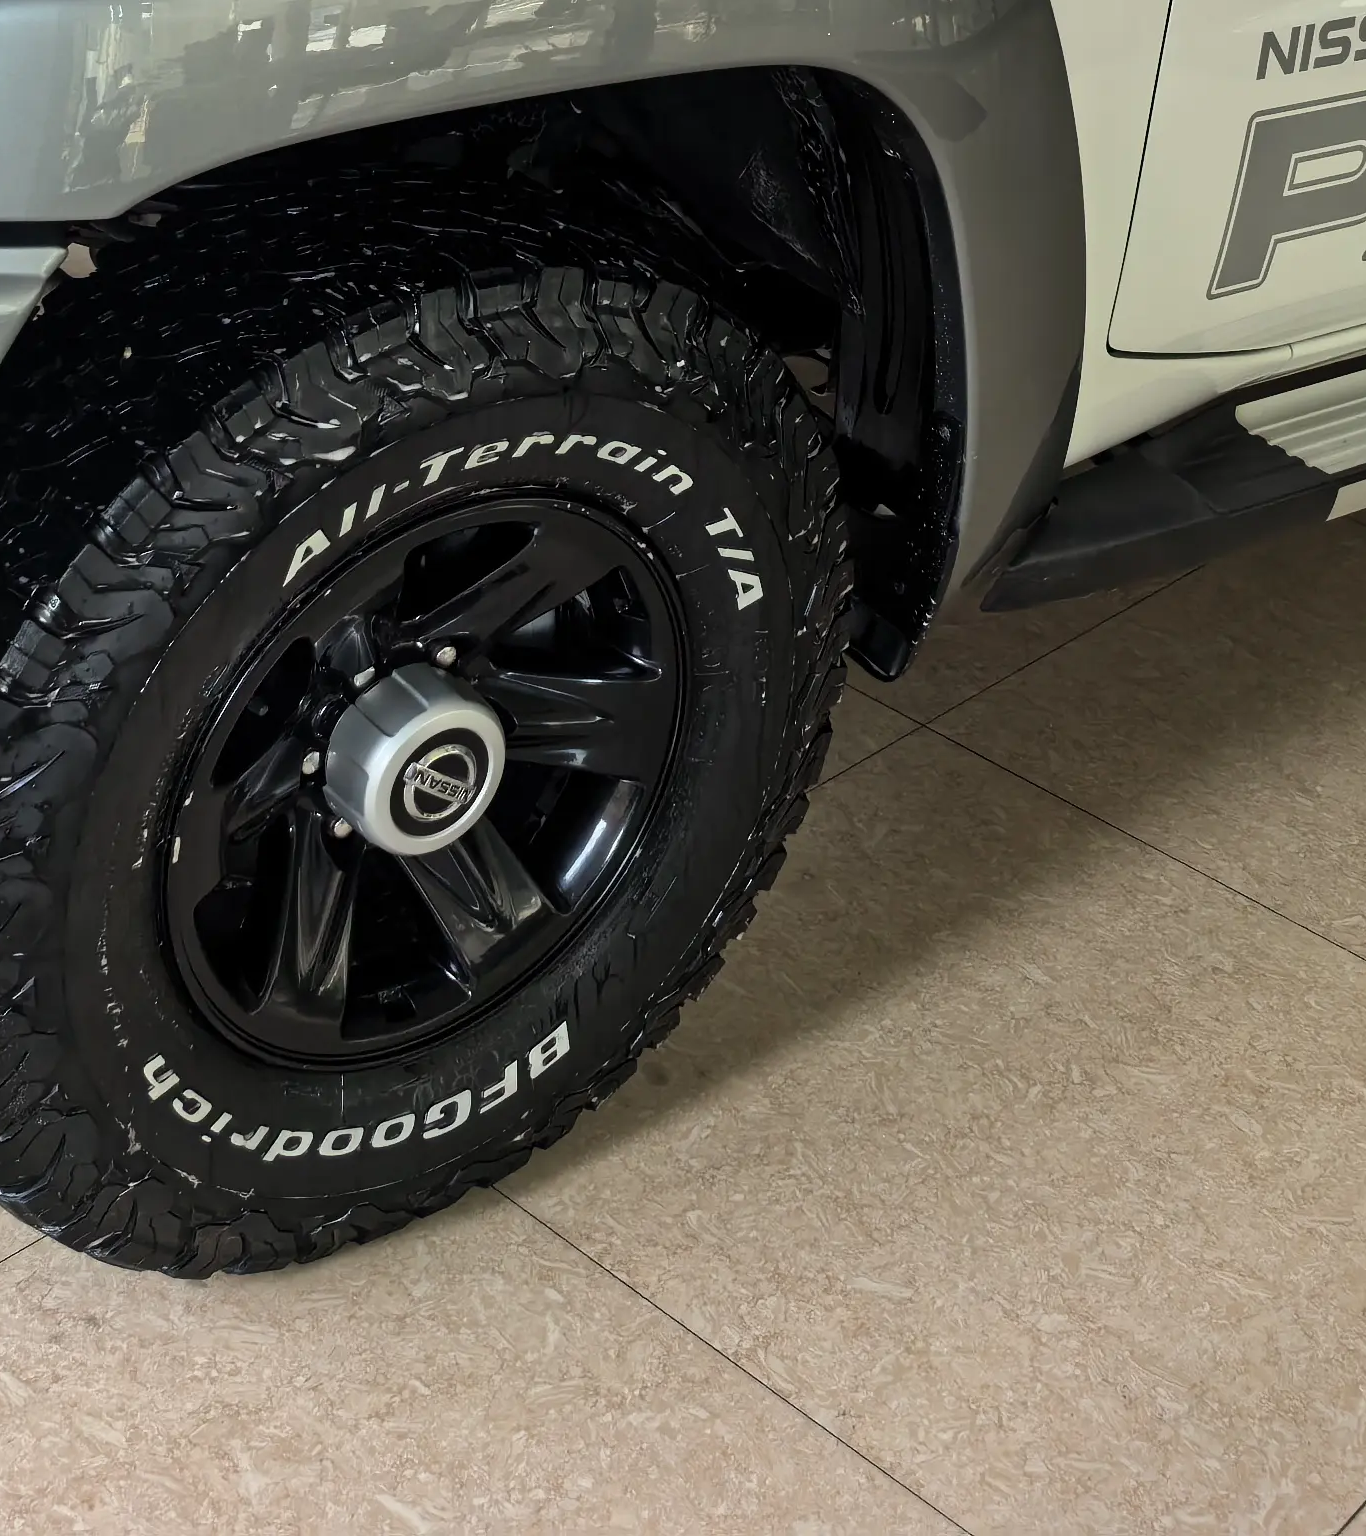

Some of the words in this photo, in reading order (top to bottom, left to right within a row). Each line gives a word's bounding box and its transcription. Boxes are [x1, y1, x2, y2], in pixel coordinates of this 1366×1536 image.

[282, 431, 694, 588] All-Terrain
[704, 506, 765, 612] T/A
[412, 768, 471, 805] NISSAN
[142, 1019, 572, 1163] BFGoodrich
